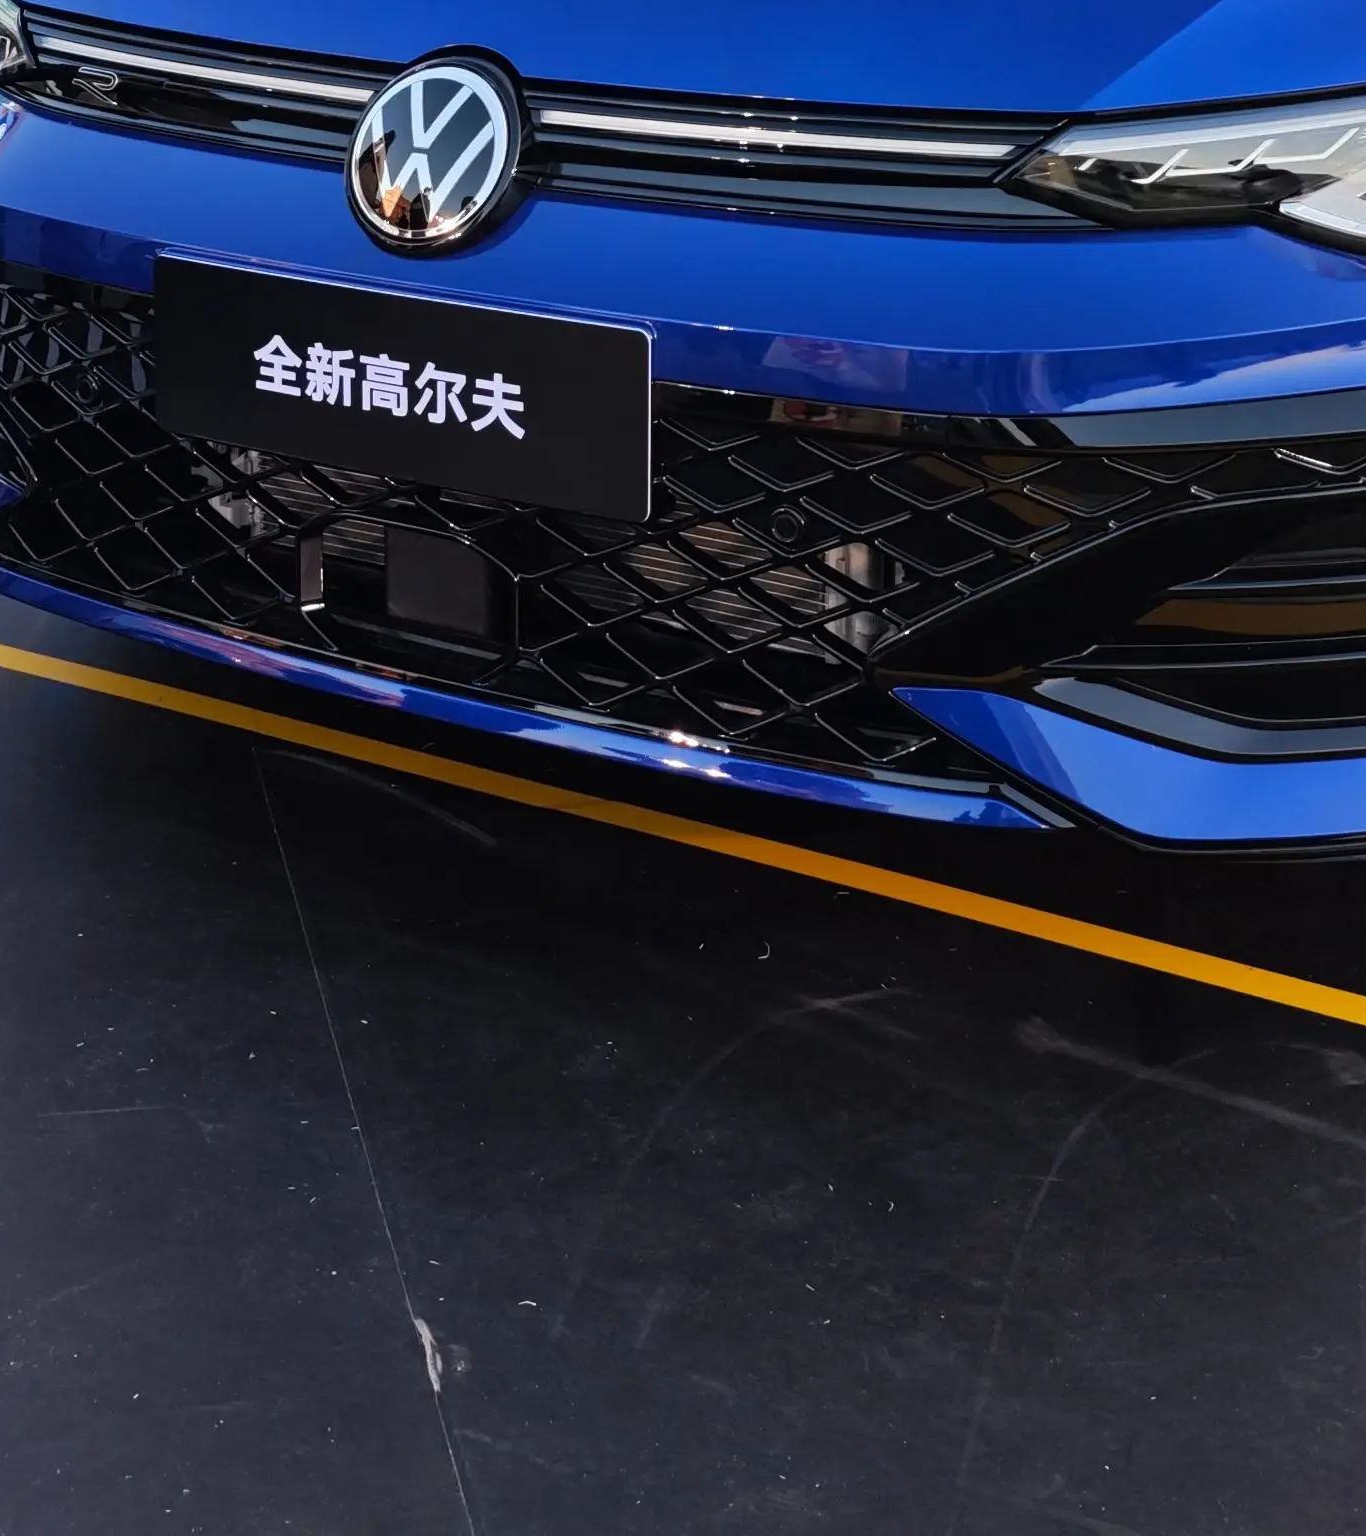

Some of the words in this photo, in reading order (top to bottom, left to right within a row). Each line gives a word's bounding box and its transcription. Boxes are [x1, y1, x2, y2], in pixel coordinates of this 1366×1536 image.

[253, 334, 526, 440] 全新高尔夫
